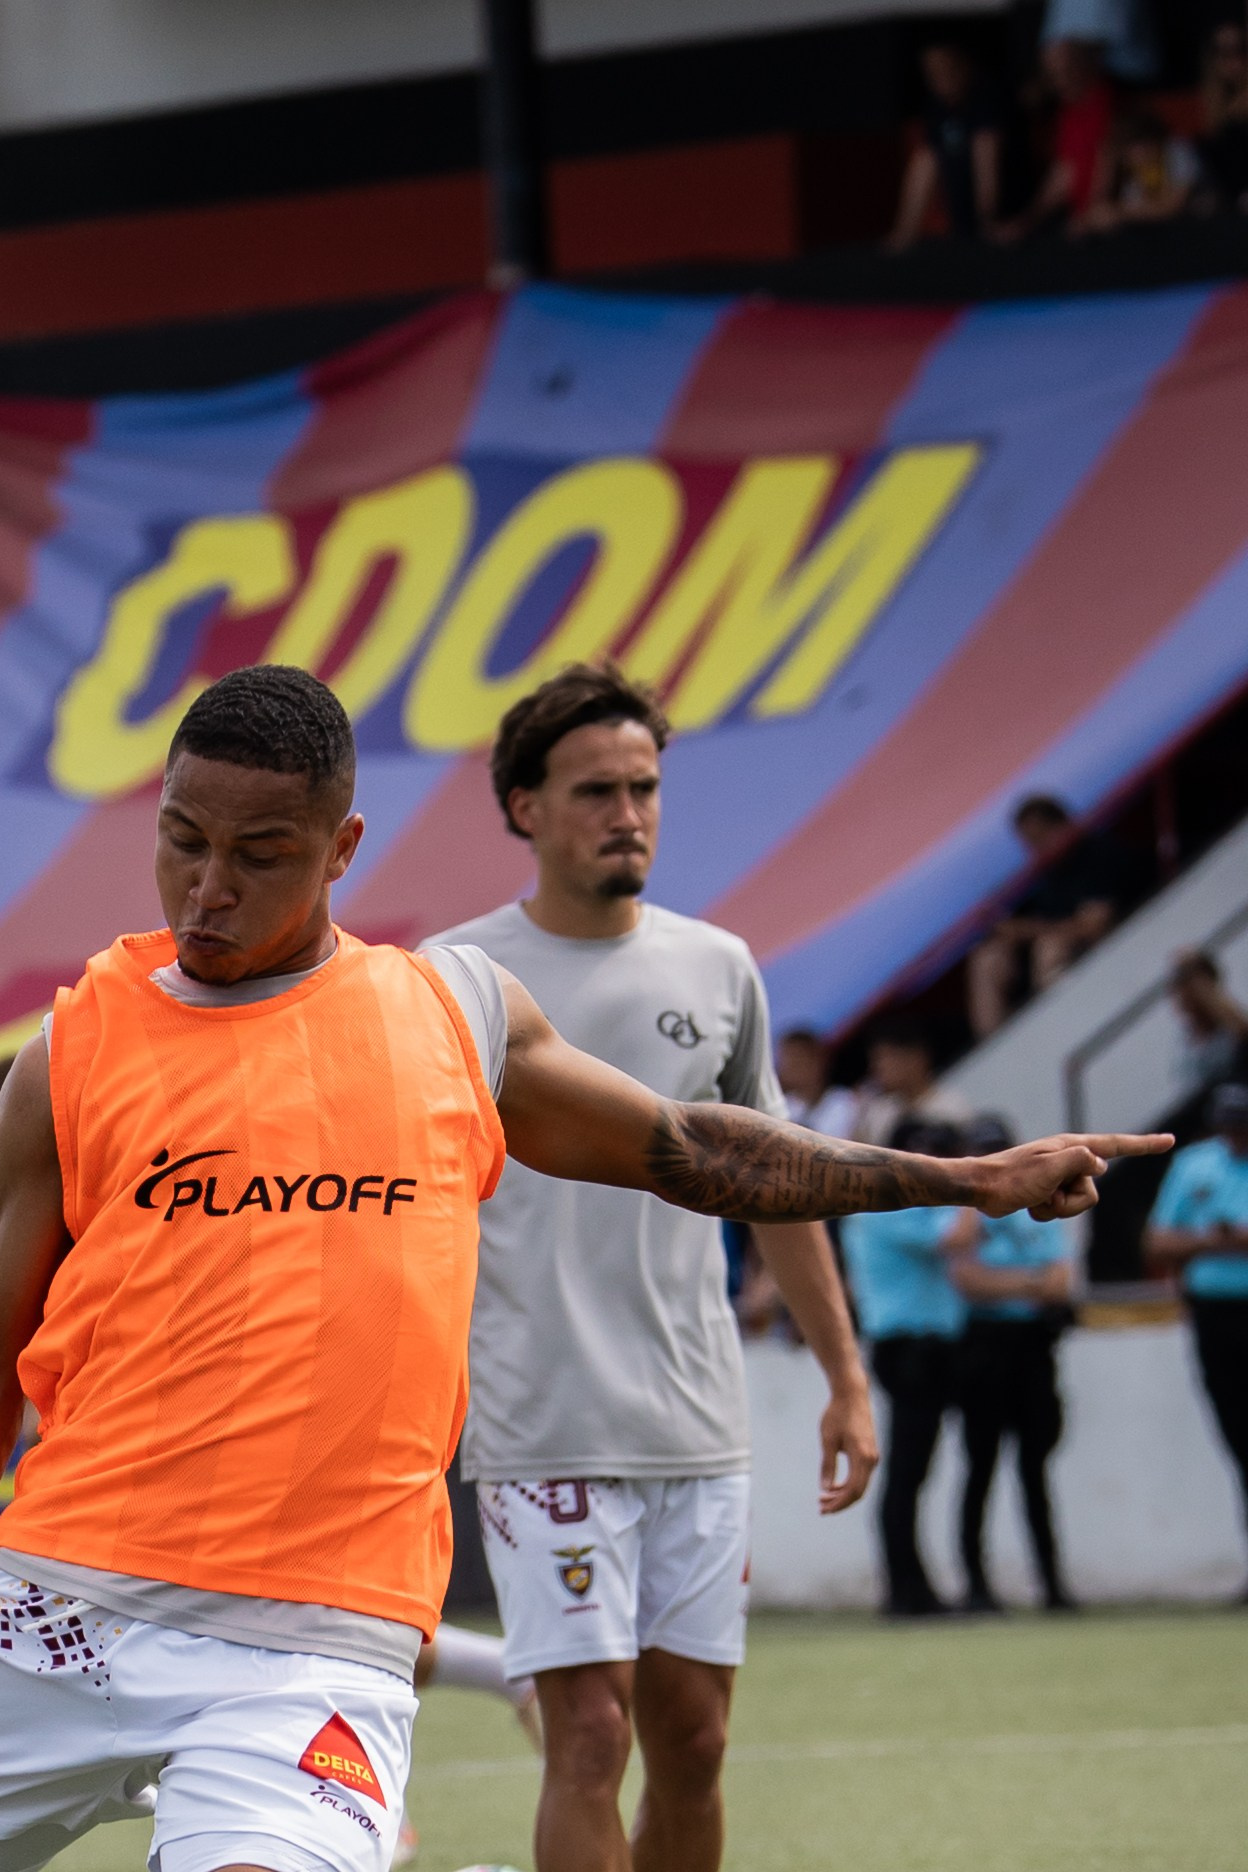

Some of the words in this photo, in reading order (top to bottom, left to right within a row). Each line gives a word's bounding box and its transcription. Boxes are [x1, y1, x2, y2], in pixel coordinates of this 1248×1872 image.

[48, 441, 984, 799] CDOM
[162, 1173, 418, 1222] PLAYOFF
[313, 1751, 374, 1785] DELTA
